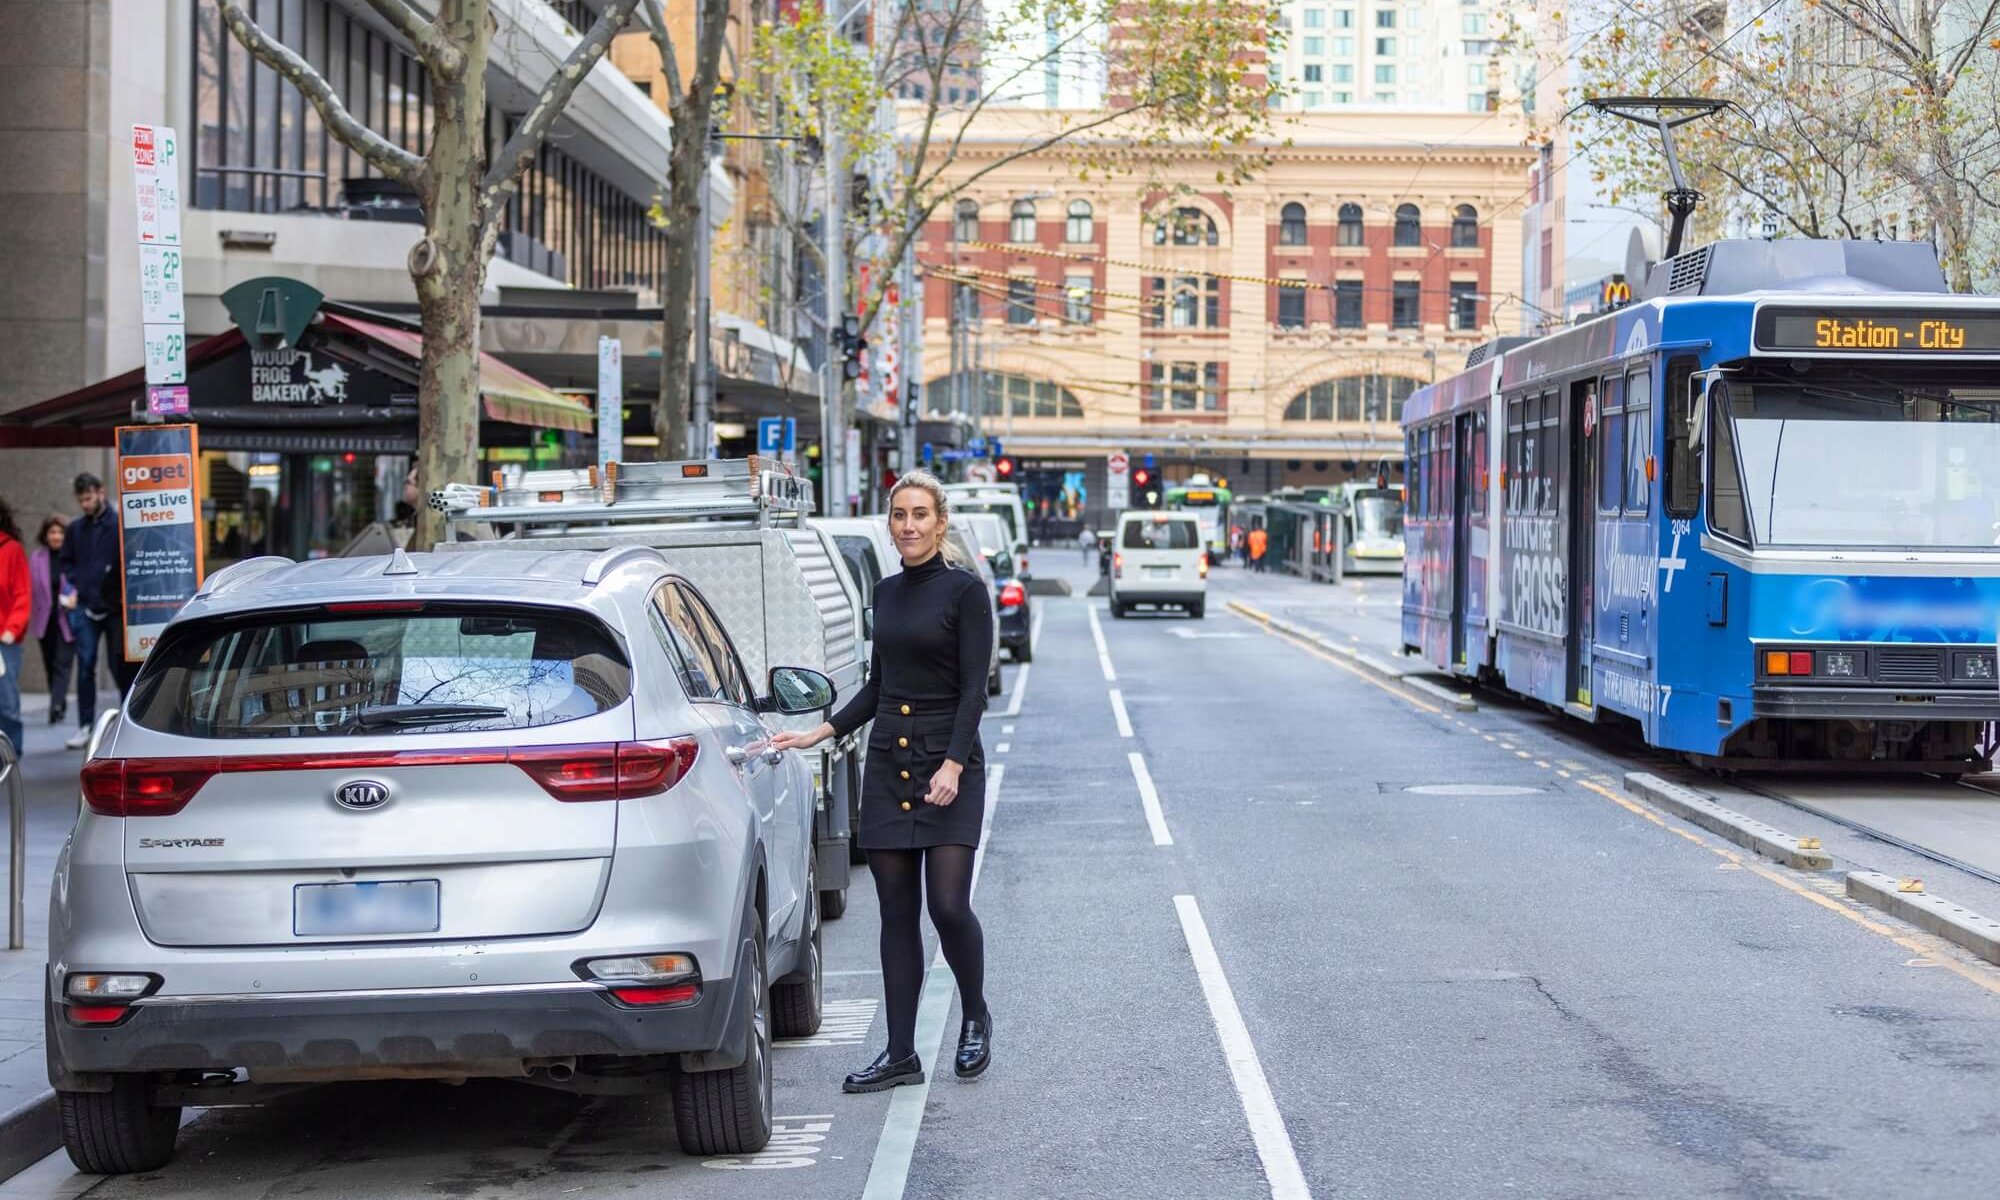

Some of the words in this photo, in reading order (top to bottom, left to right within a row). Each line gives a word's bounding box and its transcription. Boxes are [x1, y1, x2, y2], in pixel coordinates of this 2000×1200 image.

[162, 251, 179, 279] 2P
[1816, 319, 1898, 348] Station
[1919, 321, 1965, 348] City
[165, 334, 182, 362] 2P
[251, 348, 298, 365] WOOD
[251, 367, 291, 383] FROG
[252, 384, 309, 402] BAKERY
[767, 424, 781, 447] F
[1517, 438, 1535, 473] LST
[125, 463, 185, 485] goget
[127, 497, 157, 509] cars
[159, 493, 187, 506] live
[141, 509, 175, 523] here
[1671, 519, 1691, 535] 2064
[1512, 553, 1563, 635] CROSS
[1656, 684, 1672, 717] 17
[345, 787, 380, 802] KIA
[139, 838, 225, 849] SPORTAGE
